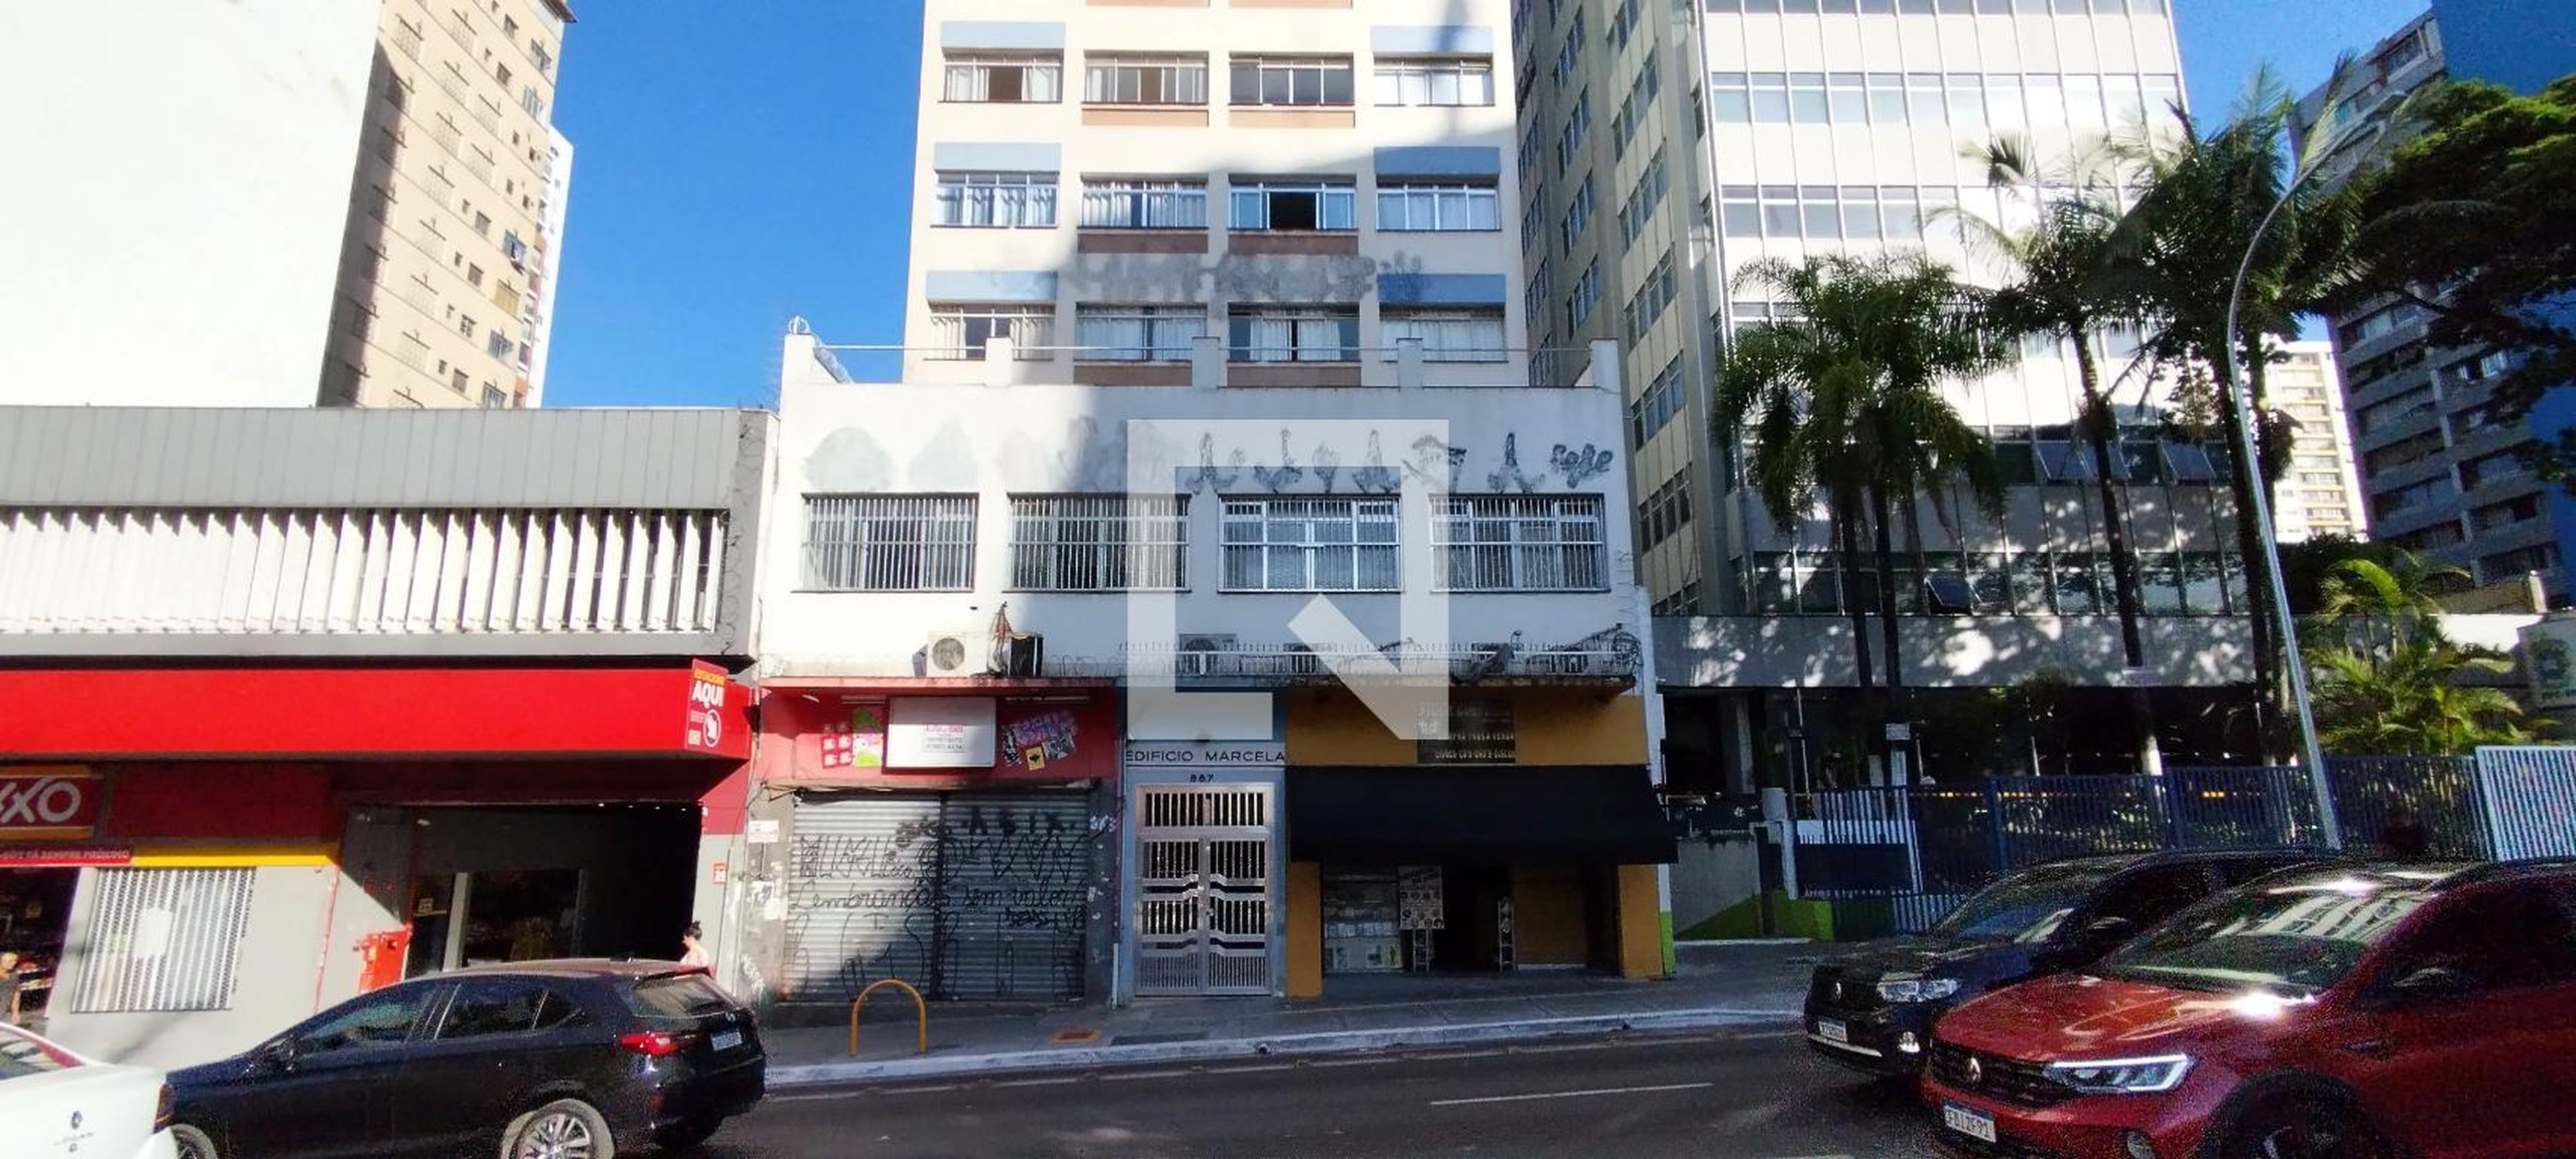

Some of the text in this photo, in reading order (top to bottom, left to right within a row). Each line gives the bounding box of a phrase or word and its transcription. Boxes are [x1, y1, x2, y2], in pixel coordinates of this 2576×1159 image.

[692, 680, 724, 708] AQUI
[1126, 751, 1285, 762] EDIFICIO MARCELA
